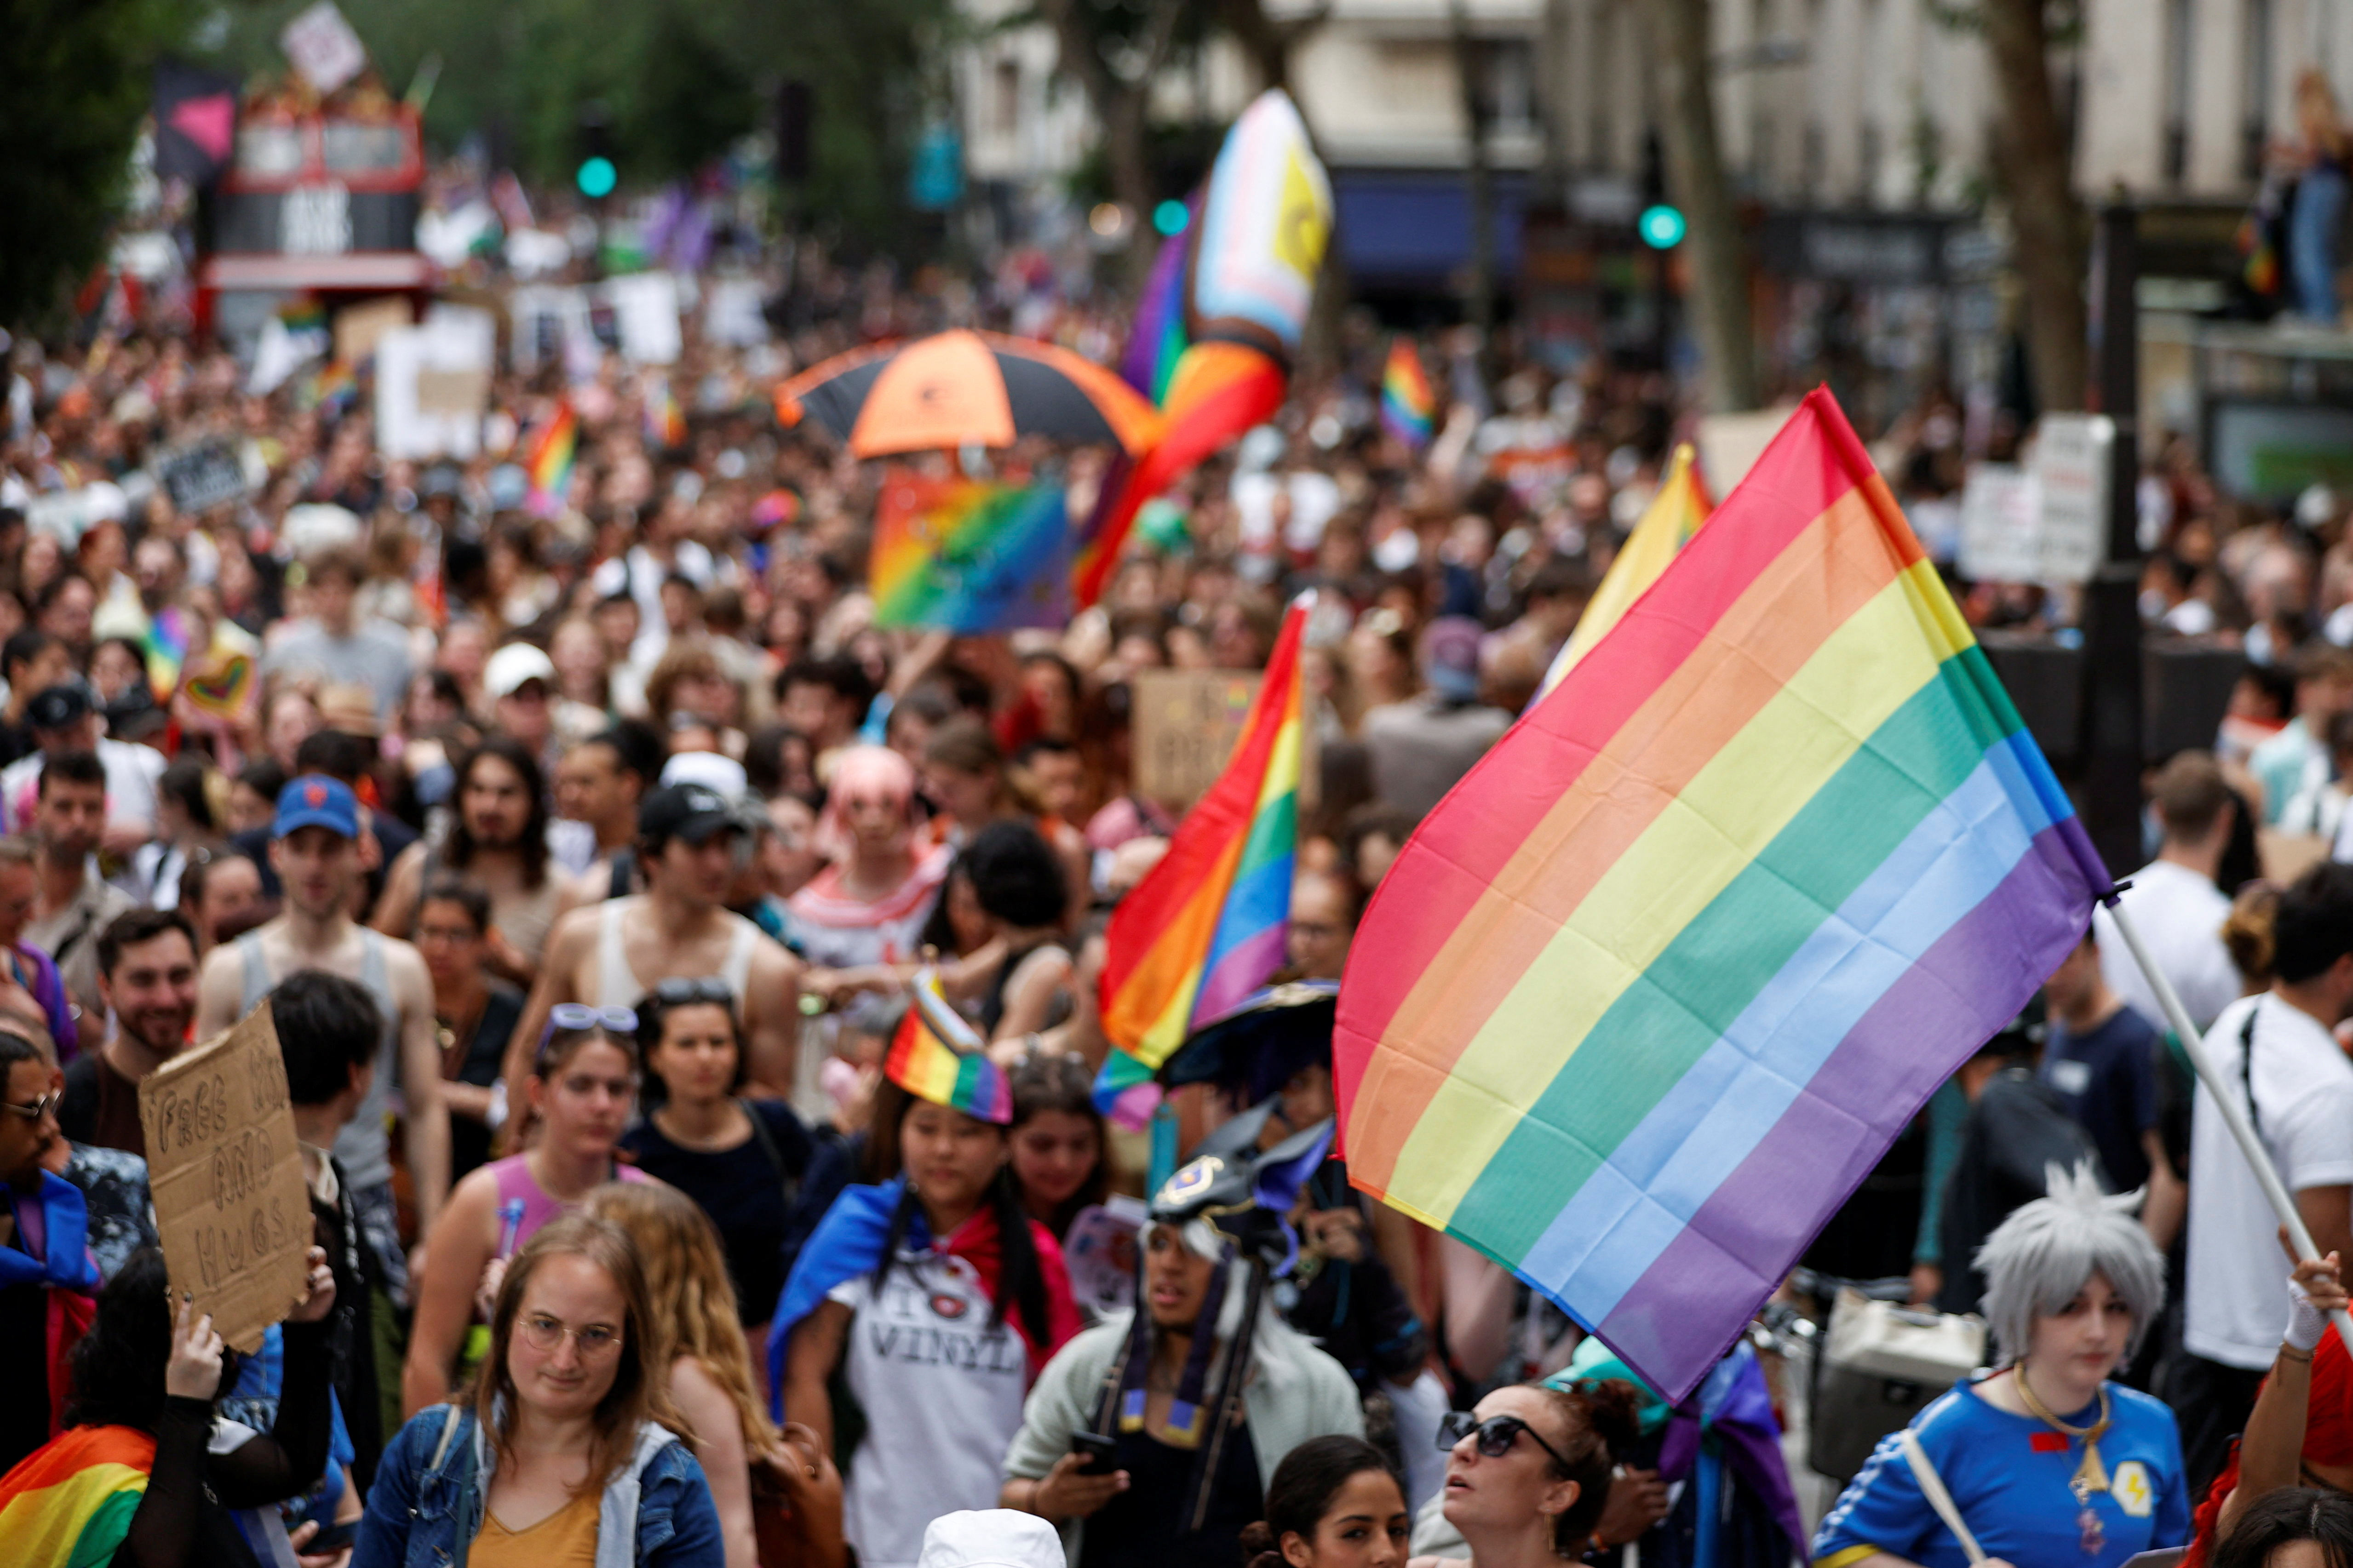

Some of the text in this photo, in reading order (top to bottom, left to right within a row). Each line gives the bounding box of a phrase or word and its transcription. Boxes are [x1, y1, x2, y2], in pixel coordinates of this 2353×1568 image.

[159, 1073, 227, 1154] FREE
[213, 1127, 274, 1211] AND
[196, 1196, 288, 1290] HUGS
